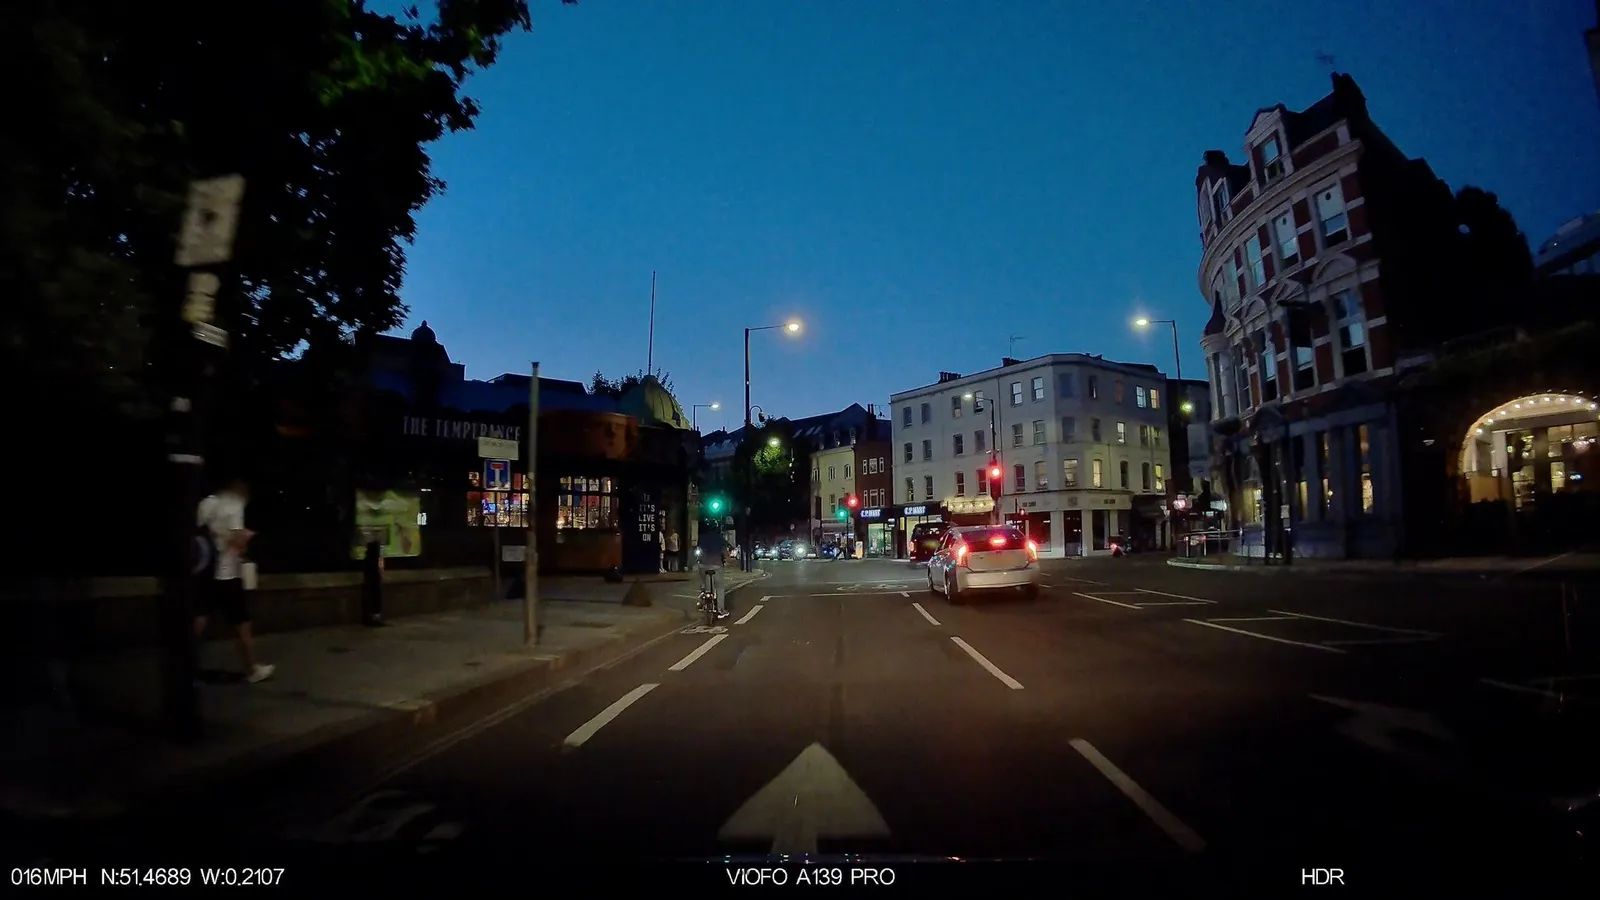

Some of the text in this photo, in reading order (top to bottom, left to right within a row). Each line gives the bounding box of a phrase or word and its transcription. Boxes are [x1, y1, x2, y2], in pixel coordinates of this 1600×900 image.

[402, 416, 522, 441] THE TEMPERANCE
[639, 504, 656, 512] IT'S
[638, 514, 656, 522] LIVE
[638, 523, 656, 532] IT'S
[642, 533, 652, 542] ON
